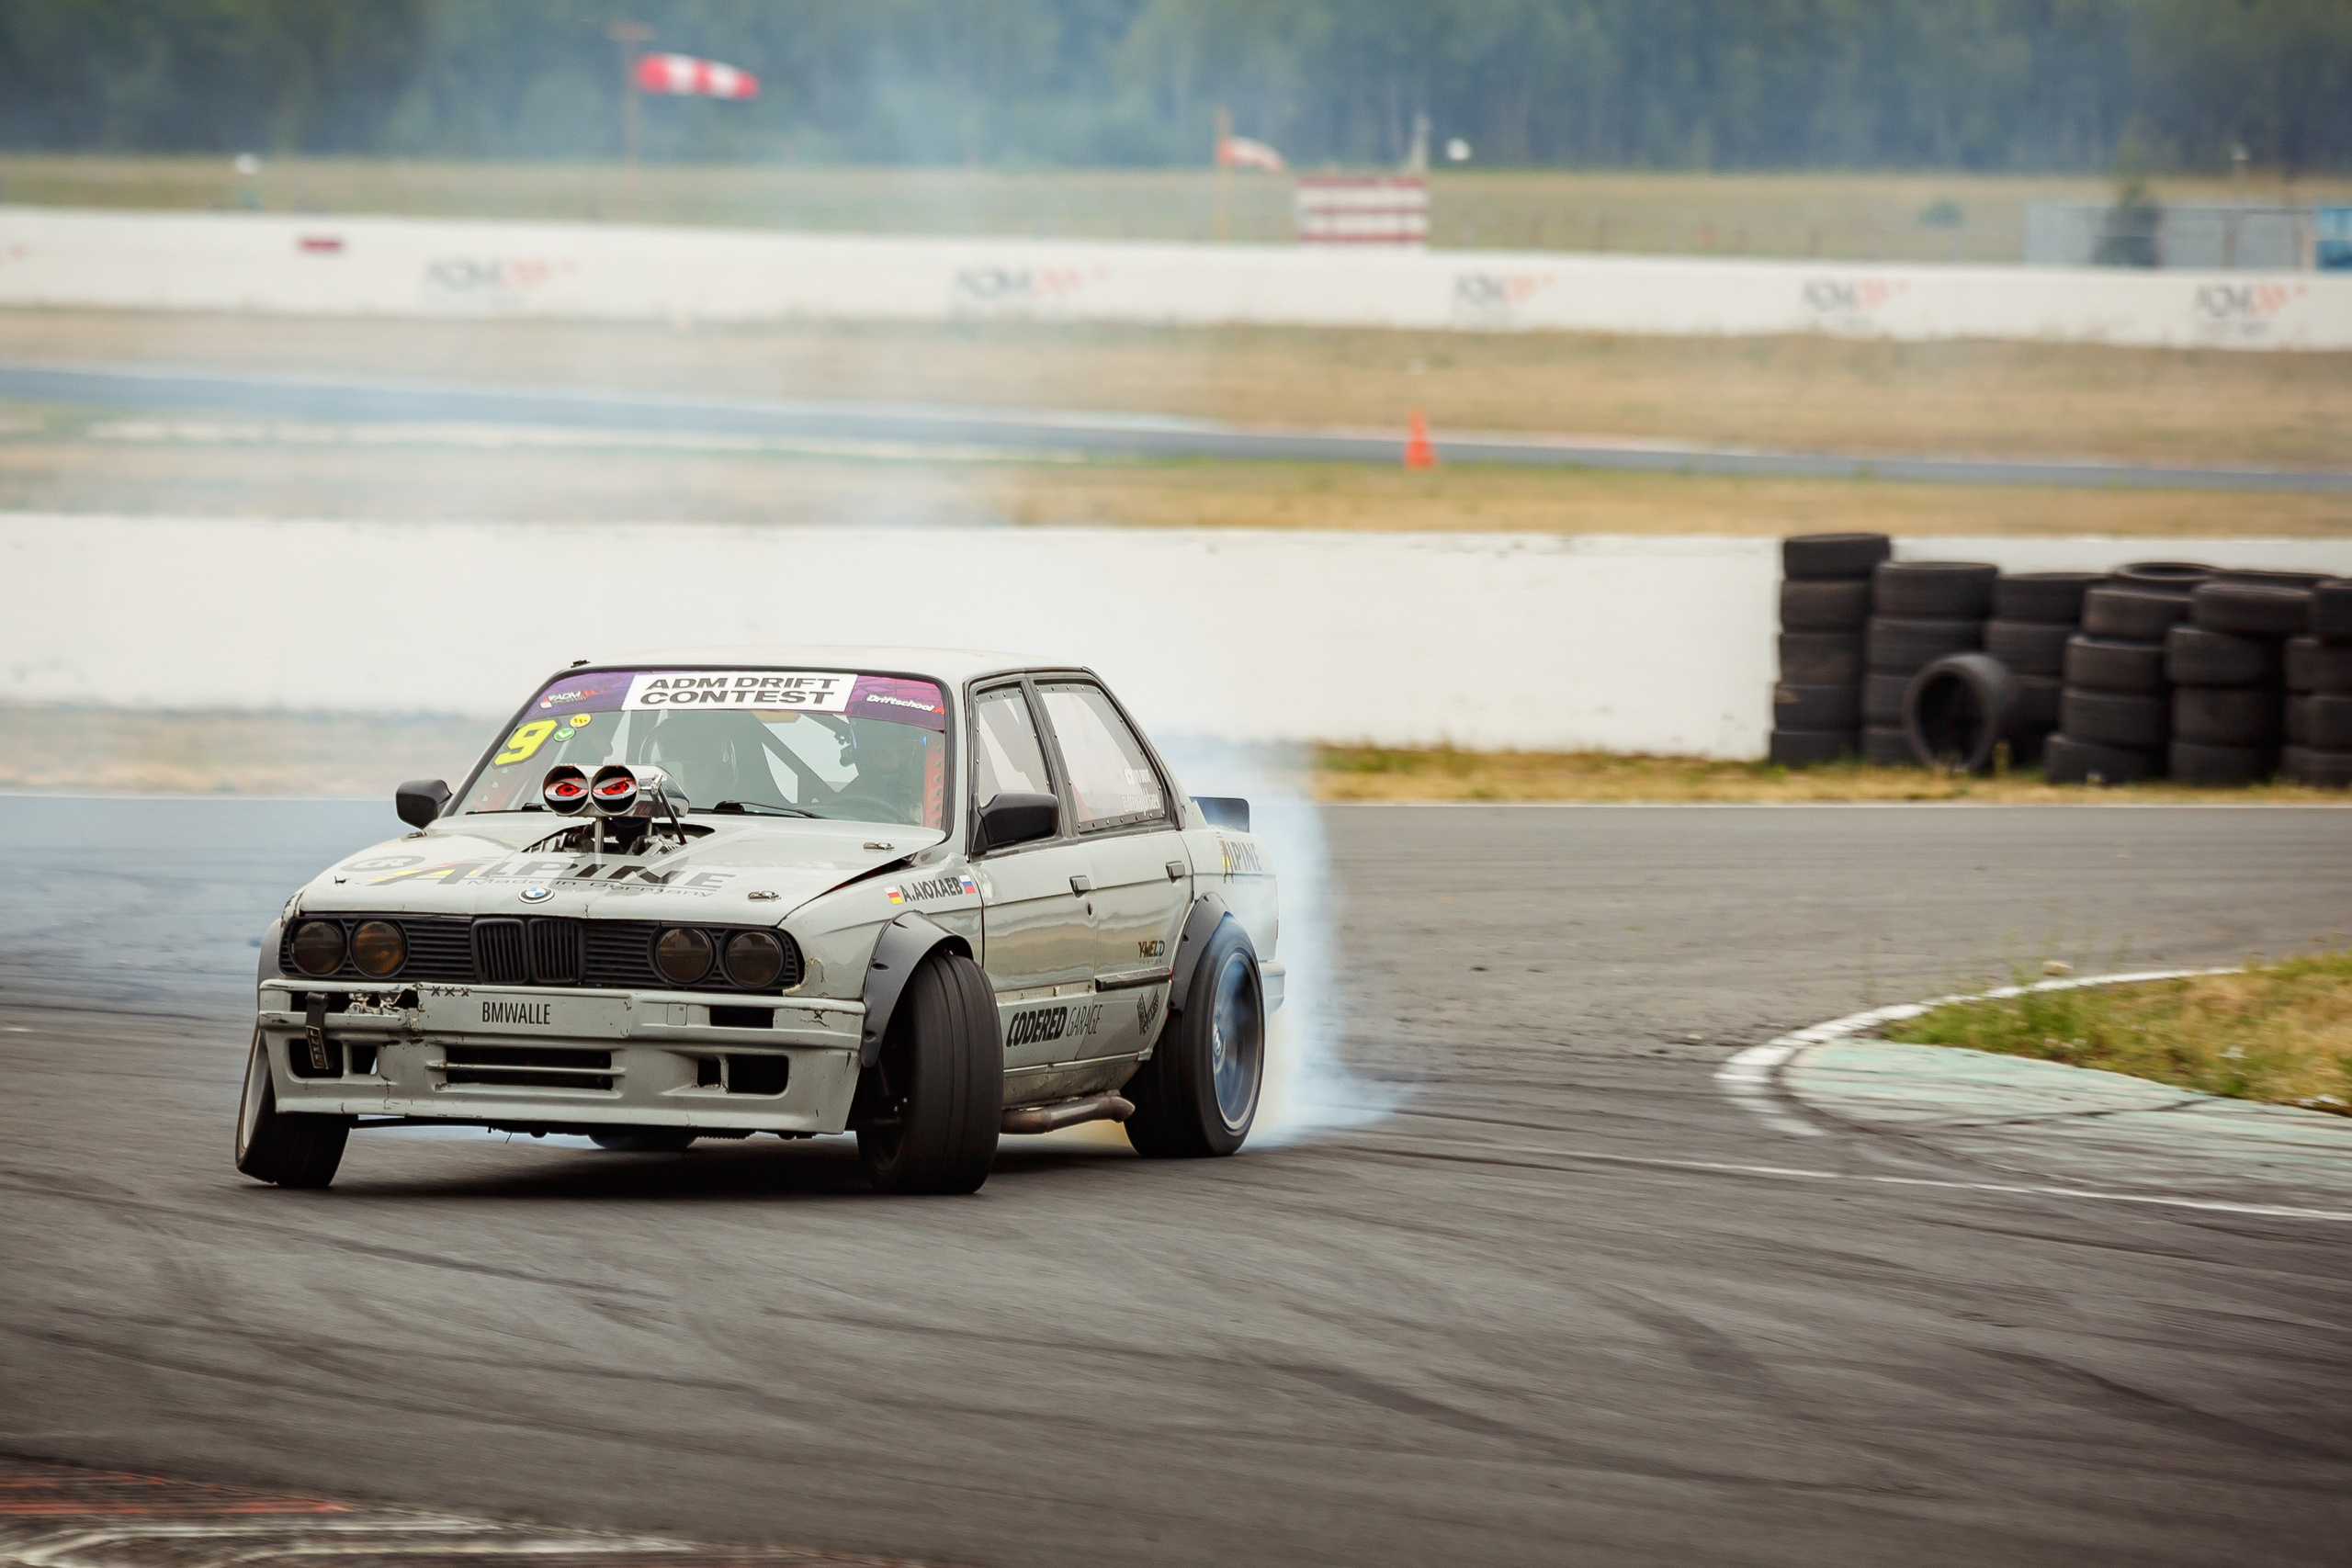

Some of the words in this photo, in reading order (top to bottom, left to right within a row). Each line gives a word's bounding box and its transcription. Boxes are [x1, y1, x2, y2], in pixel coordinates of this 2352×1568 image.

[646, 678, 729, 690] ADM
[734, 677, 840, 689] DRIFT
[640, 691, 834, 705] CONTEST
[493, 719, 558, 766] 9
[366, 861, 735, 888] ALPINE
[590, 882, 714, 897] Germany
[482, 1001, 550, 1024] BMWALLE
[1006, 1006, 1068, 1047] CODERED
[1066, 1005, 1103, 1037] GARAGE
